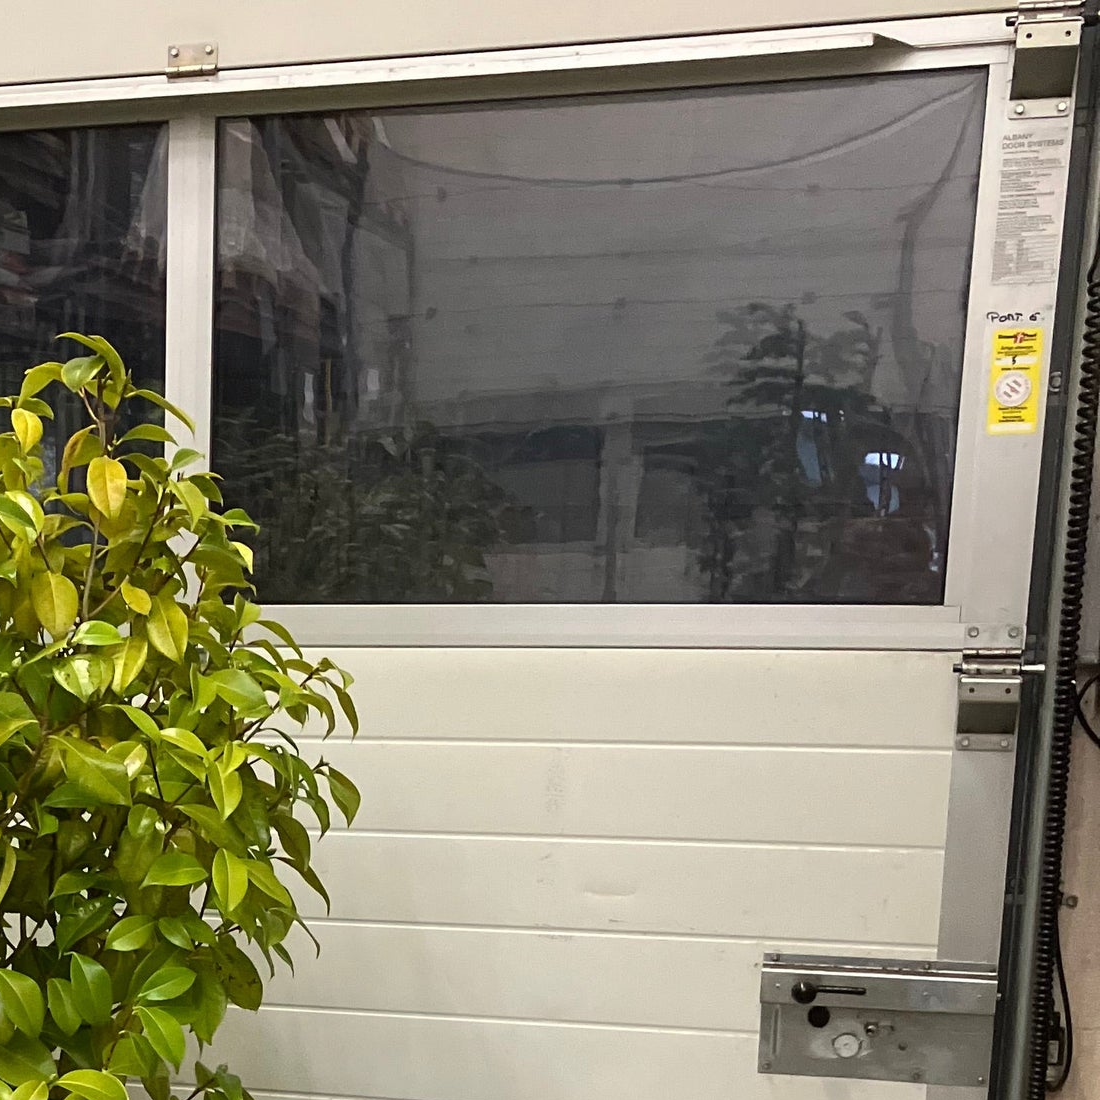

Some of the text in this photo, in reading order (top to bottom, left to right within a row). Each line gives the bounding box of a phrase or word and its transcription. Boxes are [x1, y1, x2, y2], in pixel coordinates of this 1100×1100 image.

[1003, 133, 1034, 141] ALBANY
[1002, 138, 1064, 150] DOOR SYSTEMS
